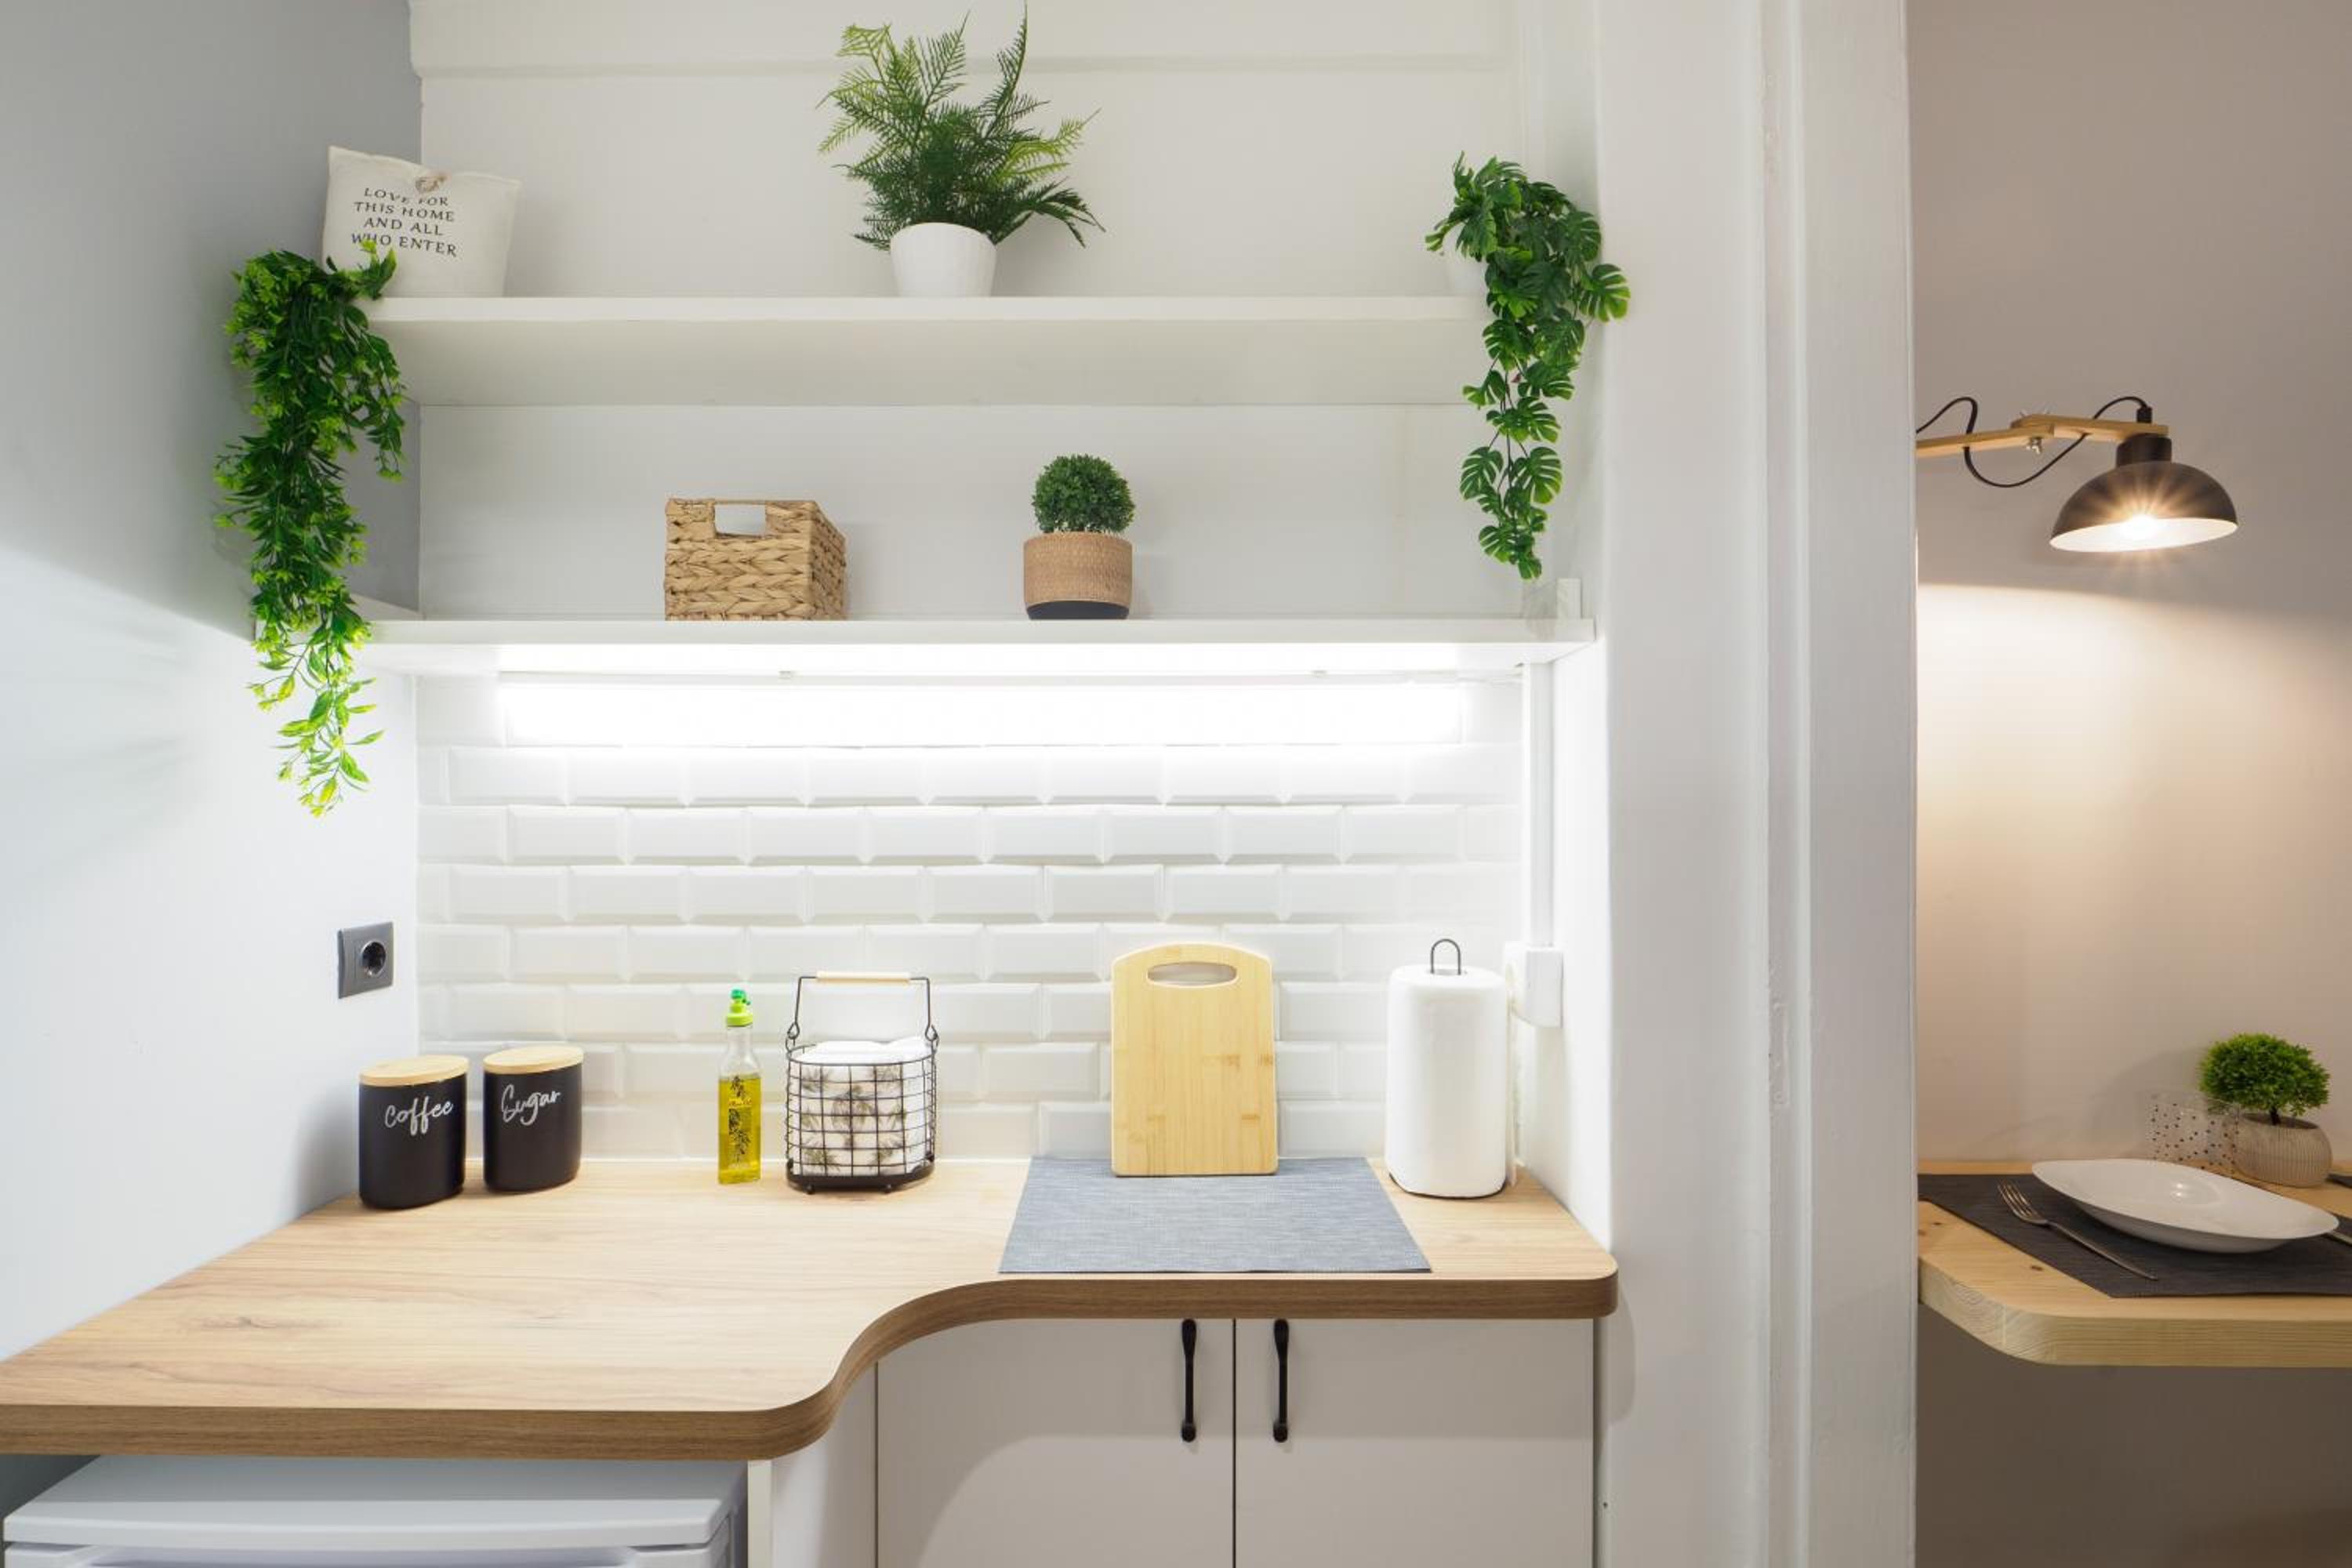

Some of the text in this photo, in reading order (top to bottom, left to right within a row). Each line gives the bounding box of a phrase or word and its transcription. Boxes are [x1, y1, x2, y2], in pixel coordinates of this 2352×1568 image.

[364, 187, 448, 206] LOVE FOR
[354, 201, 455, 222] THIS HOME
[363, 217, 444, 236] AND ALL
[399, 236, 457, 257] ENTER
[501, 1083, 561, 1126] Sugar
[384, 1096, 453, 1136] Coffee
